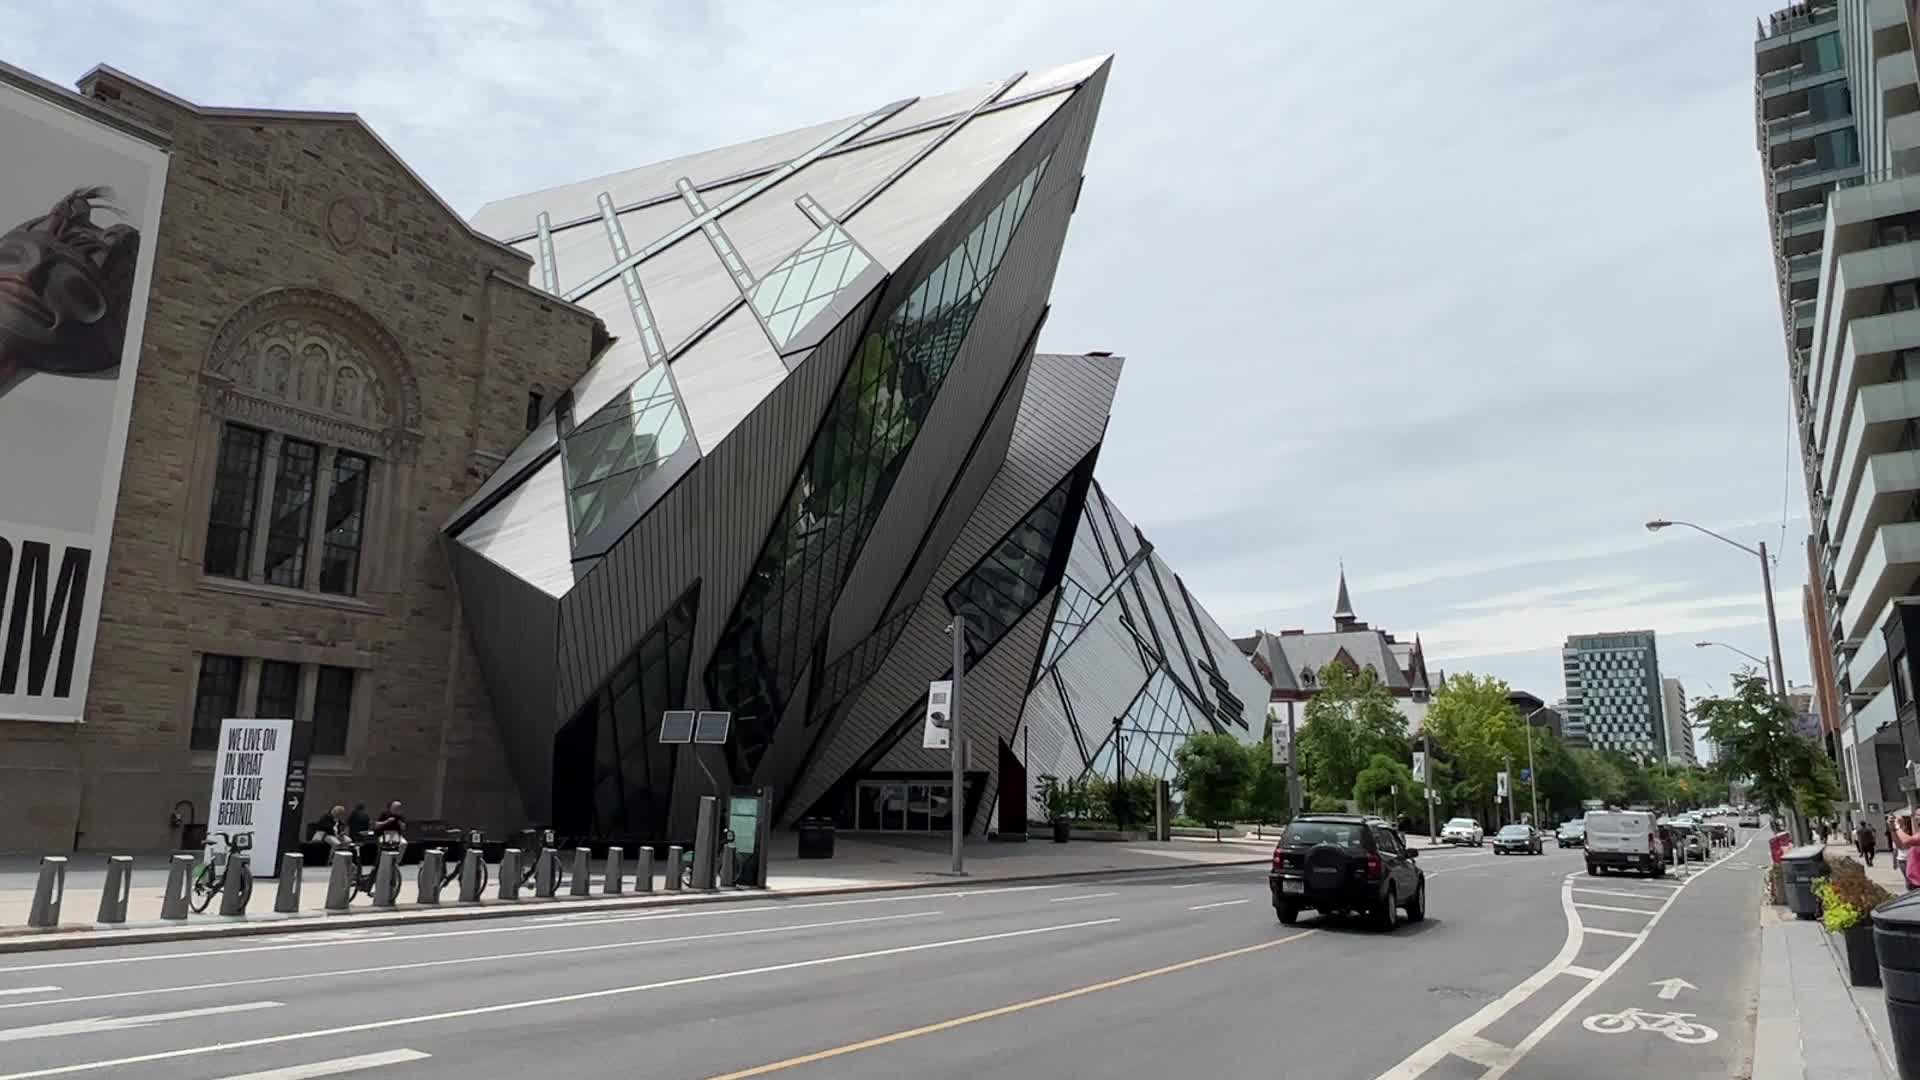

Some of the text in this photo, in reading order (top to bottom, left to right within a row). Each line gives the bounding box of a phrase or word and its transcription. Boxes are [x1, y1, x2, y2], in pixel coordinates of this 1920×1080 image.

[0, 536, 92, 698] M
[228, 728, 278, 751] WE LIVE ON
[224, 753, 264, 776] IN WHAT
[221, 778, 263, 800] WE LEAVE
[218, 803, 253, 825] BEHIND.
